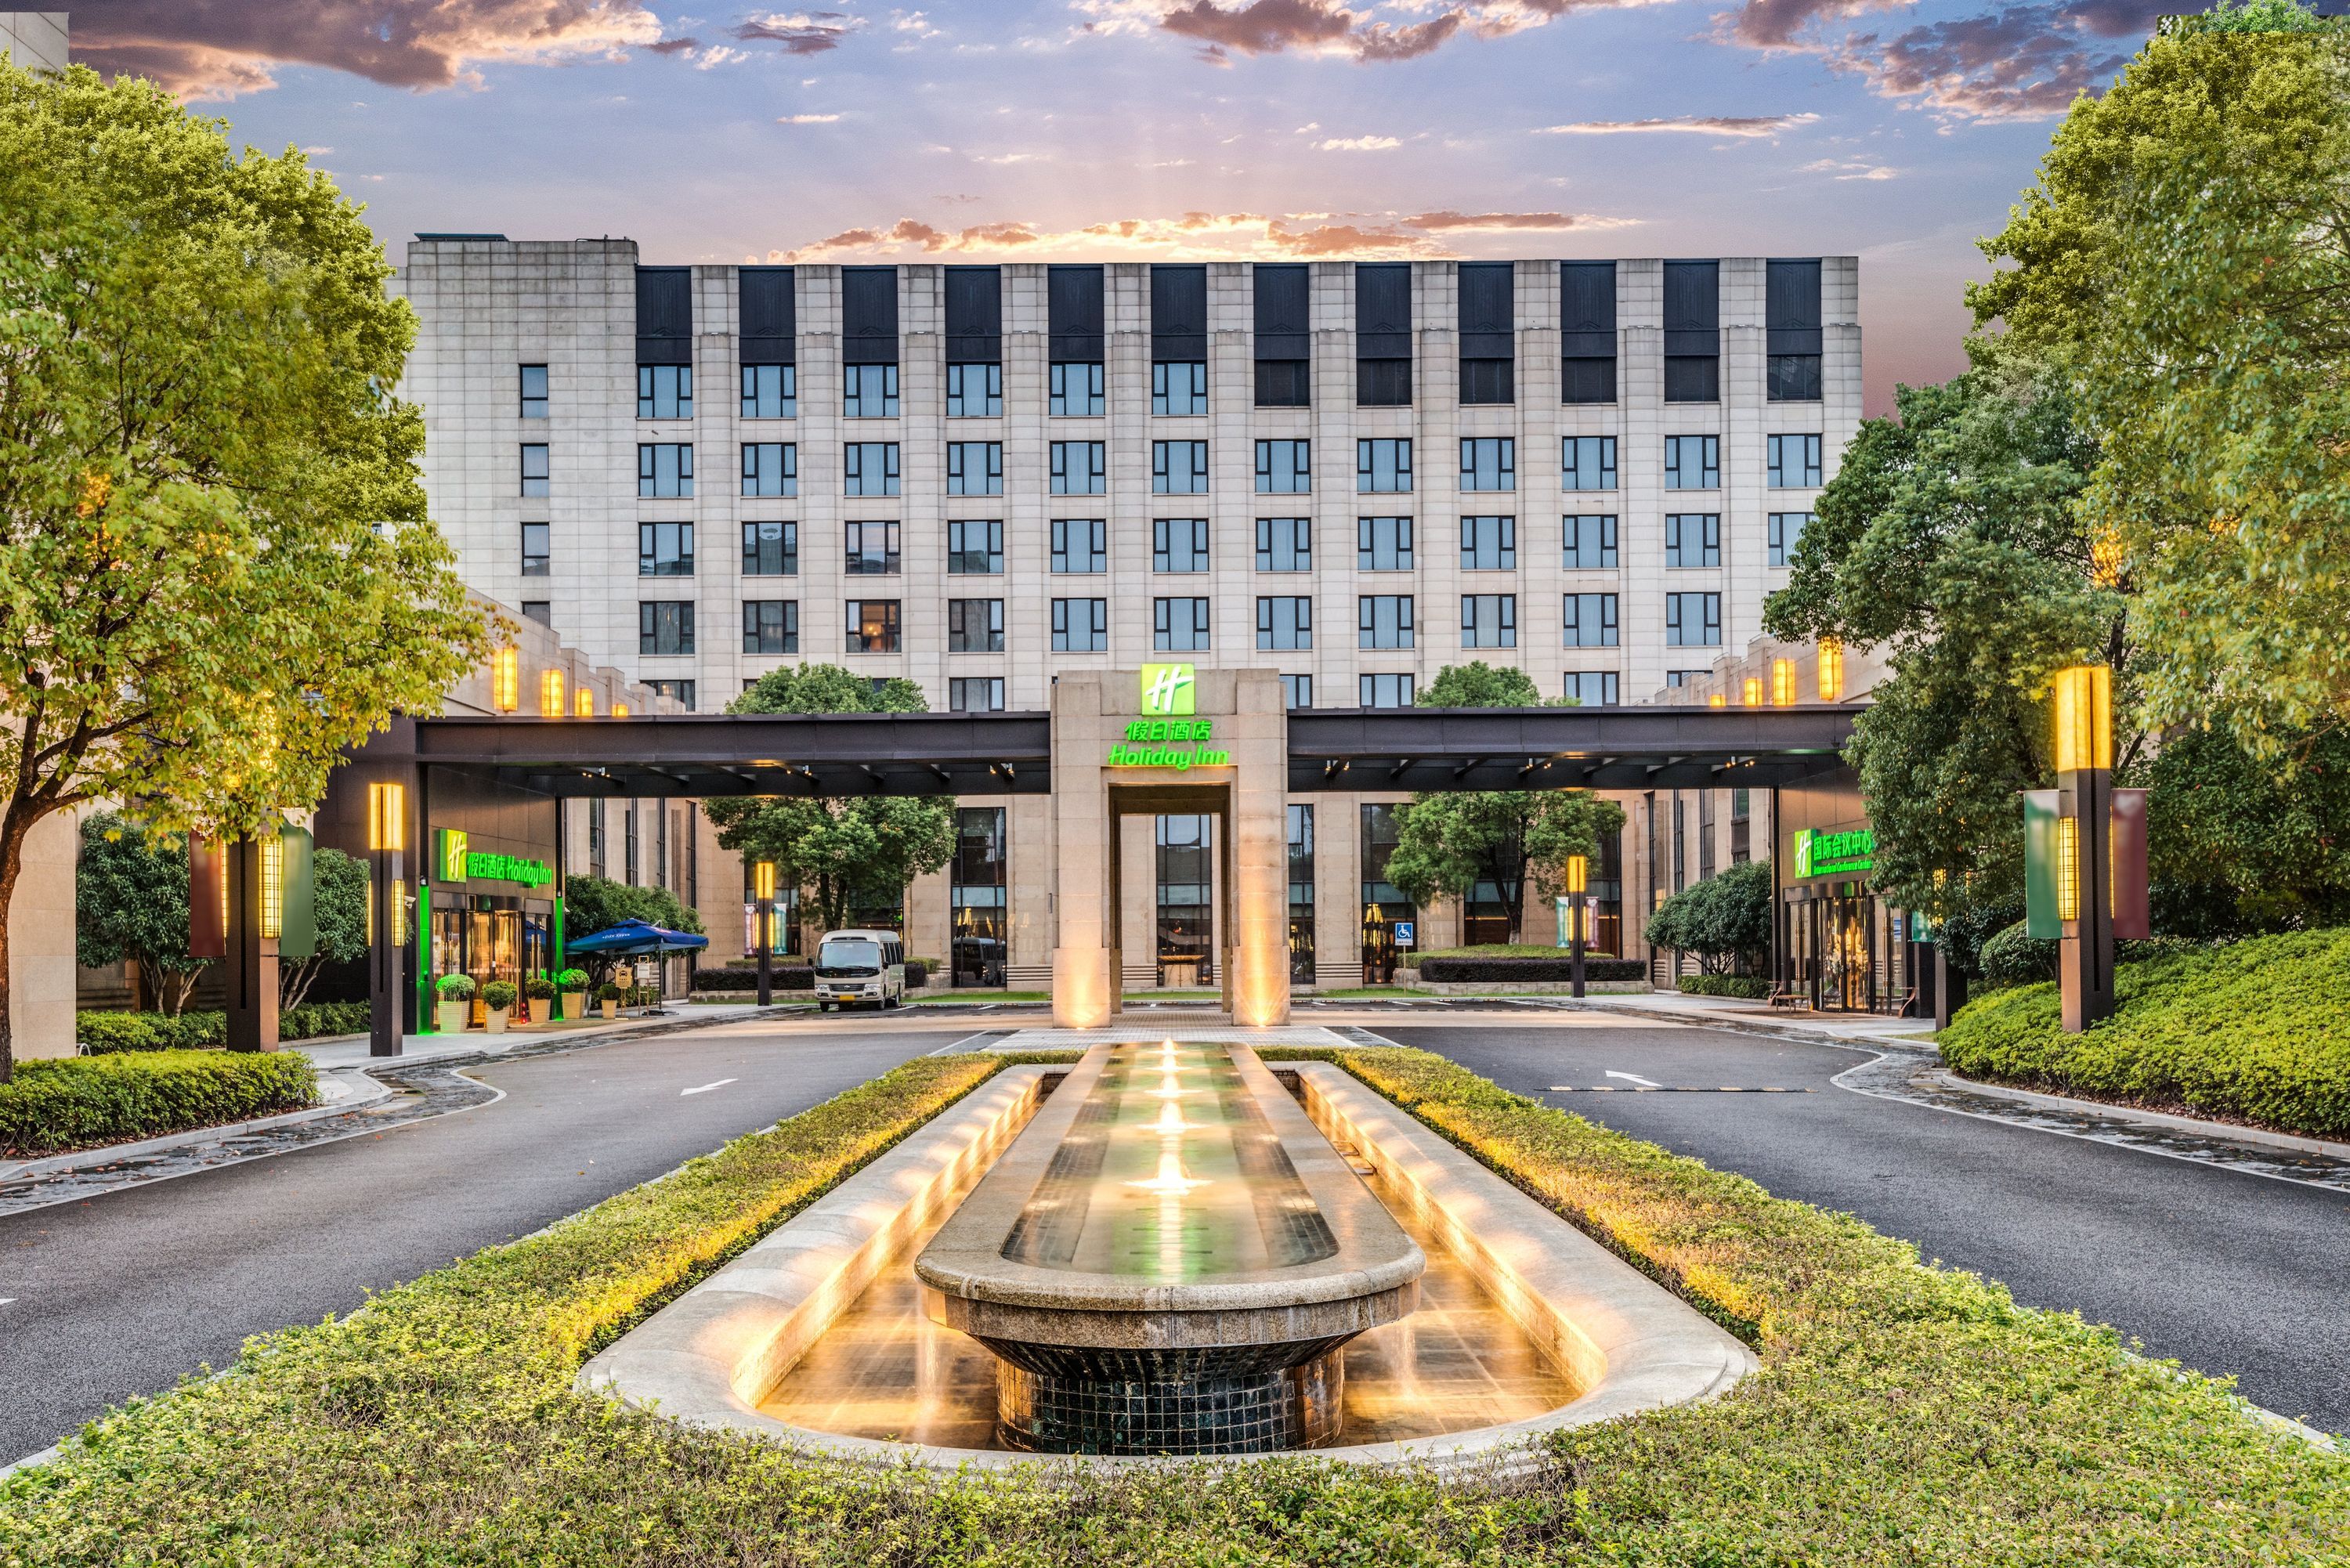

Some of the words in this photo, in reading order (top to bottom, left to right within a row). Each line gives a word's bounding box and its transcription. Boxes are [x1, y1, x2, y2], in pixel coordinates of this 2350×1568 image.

[1125, 721, 1212, 741] 假日酒店
[1108, 745, 1191, 770] Holiday
[1195, 745, 1230, 764] Inn
[1813, 829, 1872, 861] 国际会议中心
[468, 851, 506, 880] 假日酒店
[507, 855, 539, 888] Holiday
[539, 860, 551, 883] Inn
